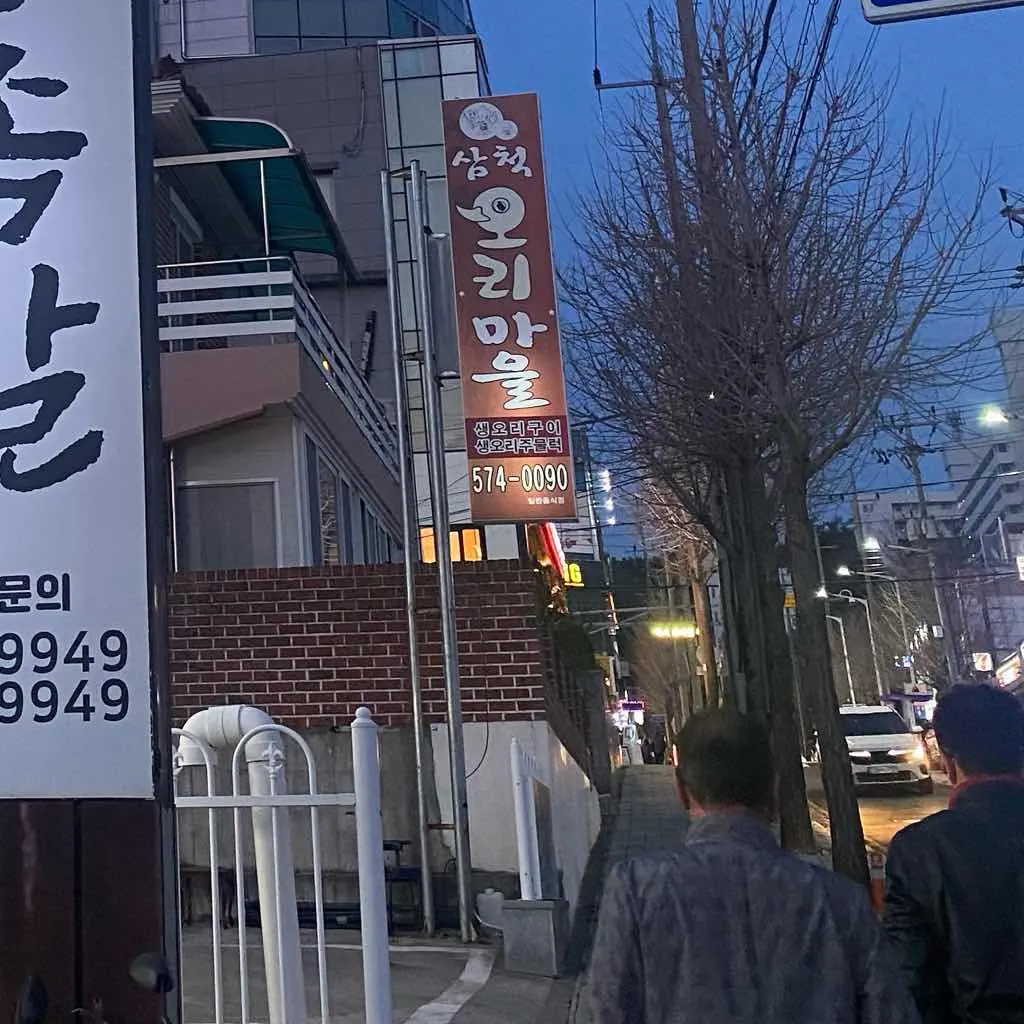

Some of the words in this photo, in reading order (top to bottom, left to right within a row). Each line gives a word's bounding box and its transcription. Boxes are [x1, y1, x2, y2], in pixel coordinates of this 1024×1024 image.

[456, 186, 552, 410] 오리마을
[473, 419, 561, 437] 생오리구이
[471, 463, 568, 494] 574-0090
